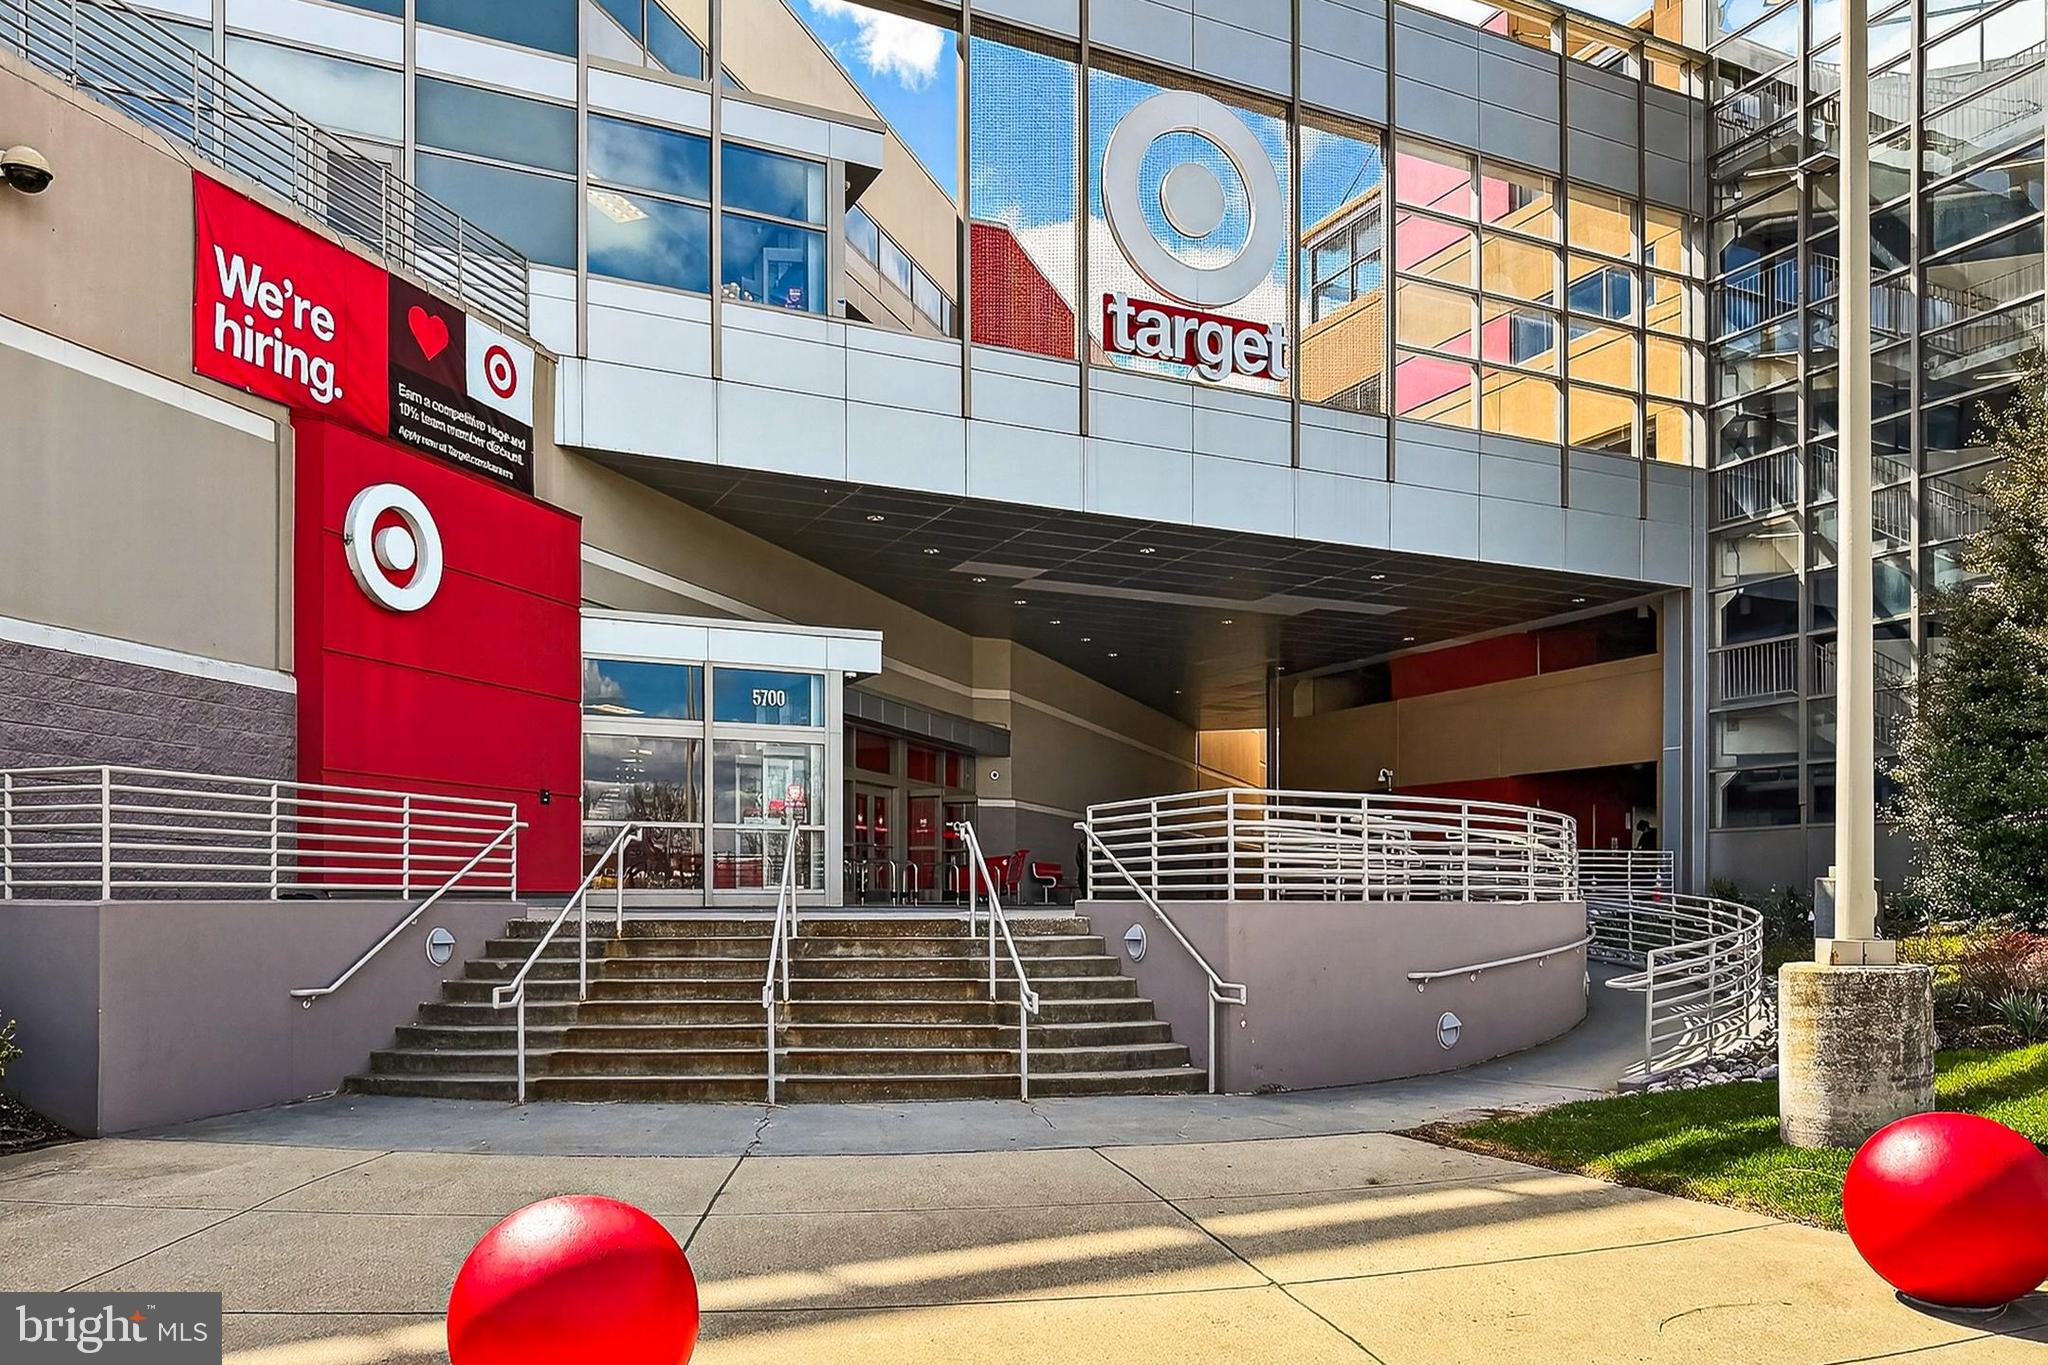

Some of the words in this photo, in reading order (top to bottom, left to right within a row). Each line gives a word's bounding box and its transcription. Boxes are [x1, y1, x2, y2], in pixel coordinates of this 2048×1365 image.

[213, 243, 336, 342] We're
[1107, 292, 1289, 381] target
[213, 302, 344, 404] hiring.
[398, 382, 422, 405] Earn
[423, 398, 431, 409] a
[399, 402, 420, 421] 10%
[421, 411, 446, 434] team
[398, 425, 421, 444] Apply
[752, 689, 786, 707] 5700
